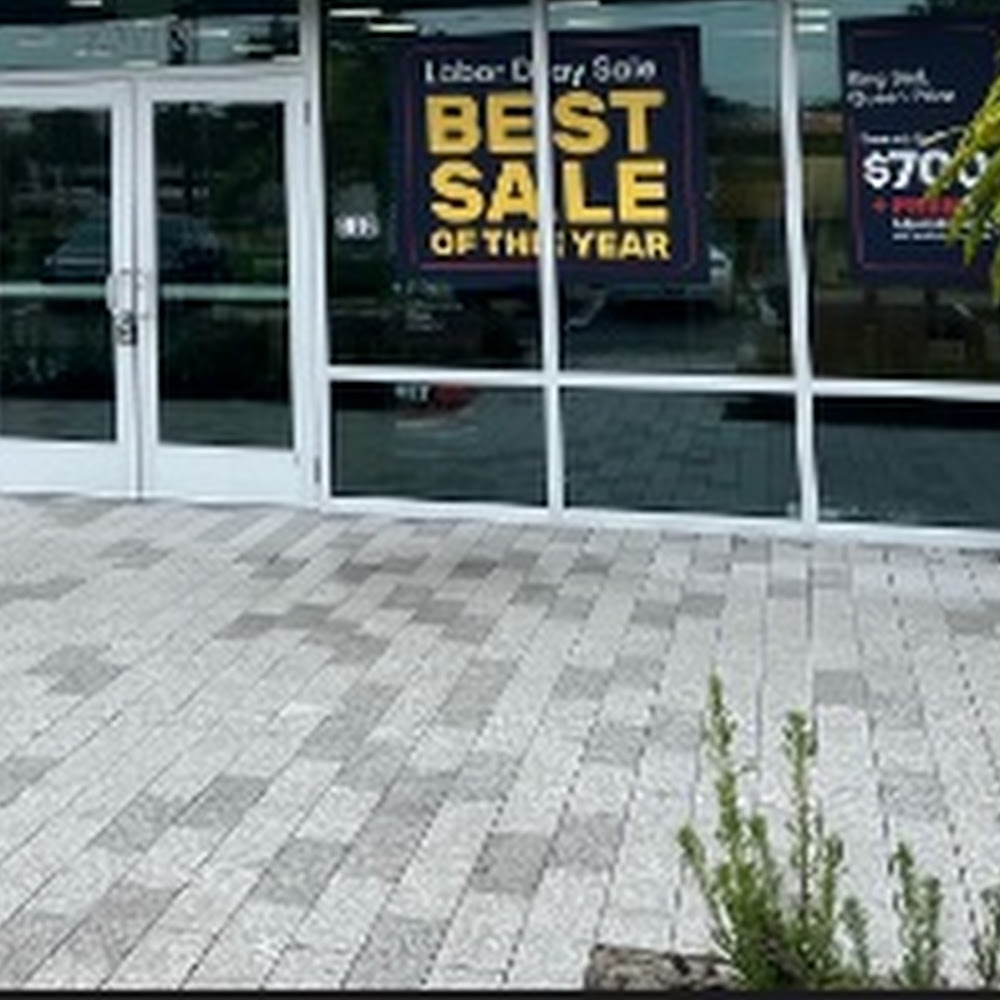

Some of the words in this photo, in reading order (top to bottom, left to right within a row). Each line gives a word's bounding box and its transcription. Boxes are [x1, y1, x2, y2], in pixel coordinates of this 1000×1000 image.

[424, 59, 504, 83] Labor
[511, 57, 586, 87] Day
[592, 55, 657, 82] Sale
[425, 88, 666, 155] BEST
[430, 160, 670, 223] SALE
[430, 228, 476, 257] OF
[570, 229, 671, 260] YEAR
